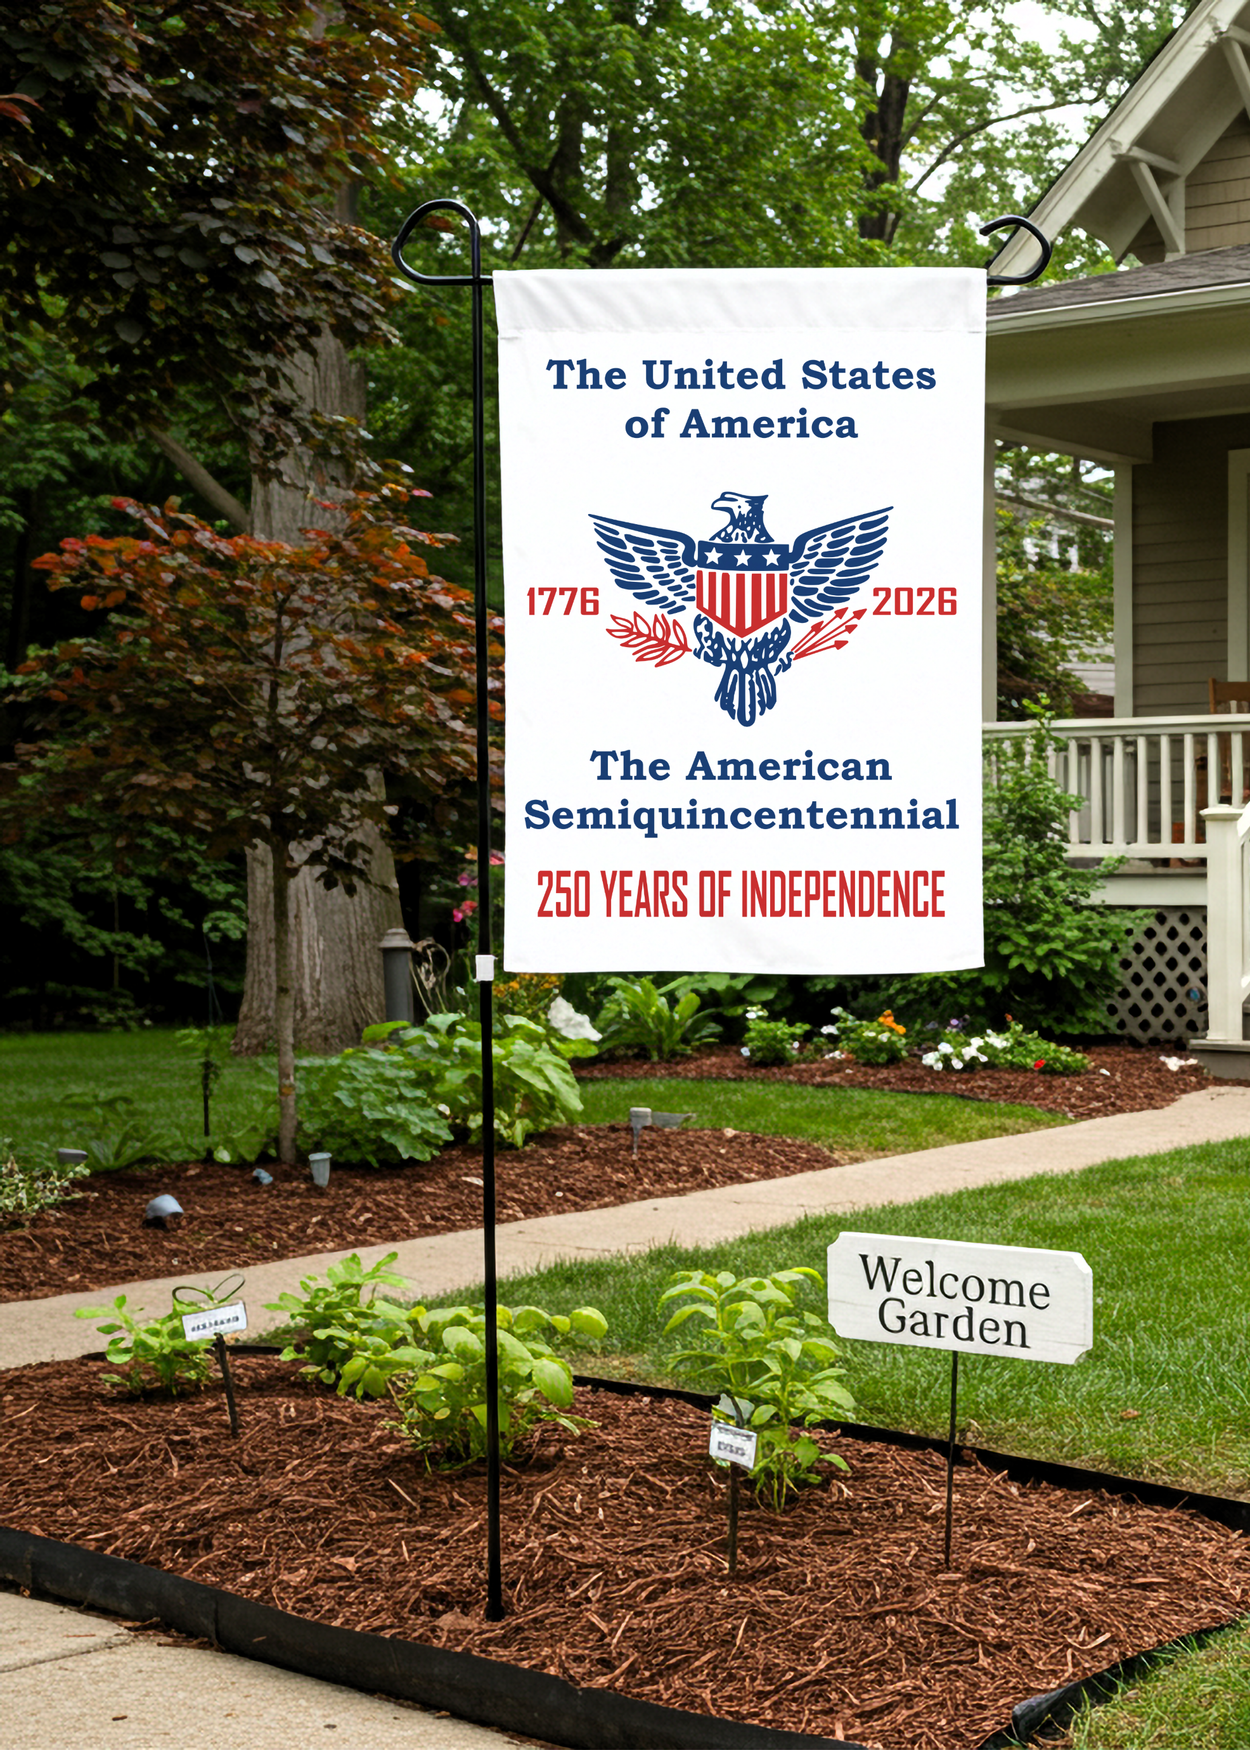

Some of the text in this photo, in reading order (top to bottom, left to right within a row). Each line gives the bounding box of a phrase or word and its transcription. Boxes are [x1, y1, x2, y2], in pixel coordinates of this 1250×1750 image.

[545, 358, 937, 390] The United States
[624, 407, 859, 439] of America
[526, 586, 600, 616] 1776
[872, 586, 957, 616] 2026
[589, 749, 893, 781] The American
[524, 798, 960, 839] Semiquincentennial
[537, 870, 946, 918] 250 YEARS OF INDEPENDENCE
[858, 1253, 1051, 1310] Welcome
[878, 1297, 1031, 1349] Garden
